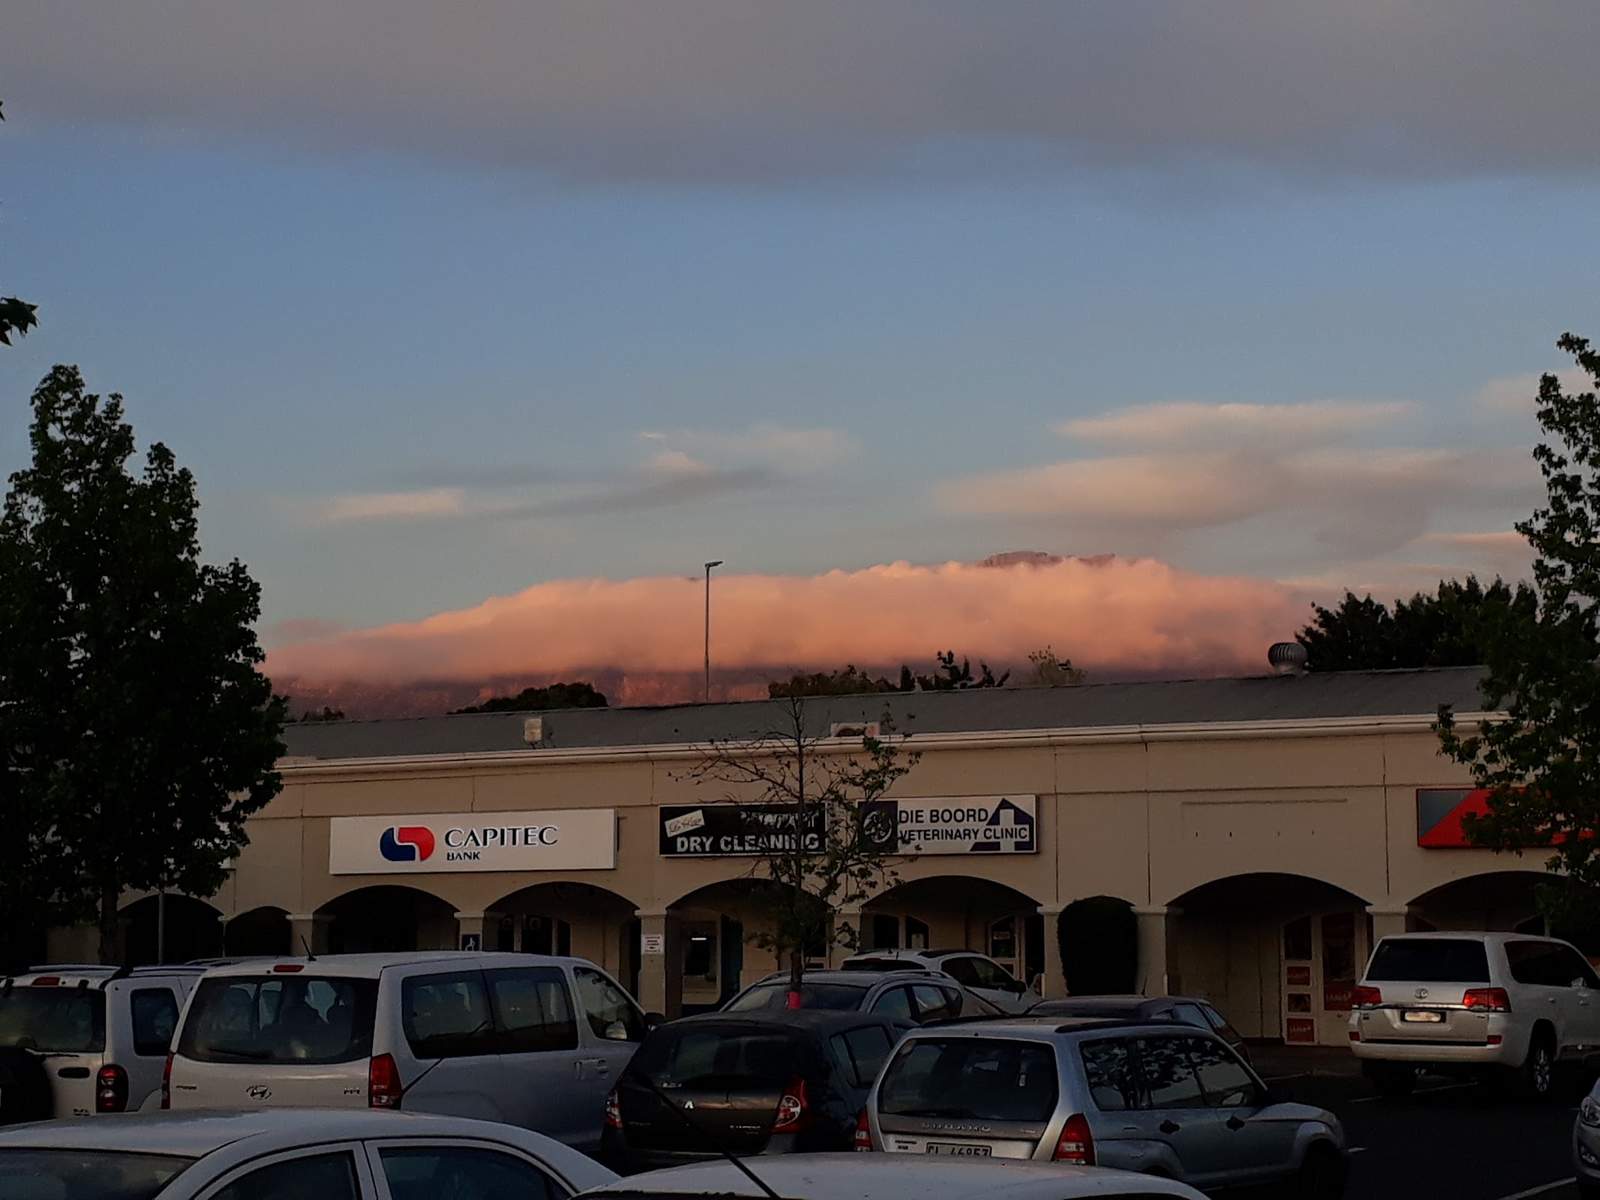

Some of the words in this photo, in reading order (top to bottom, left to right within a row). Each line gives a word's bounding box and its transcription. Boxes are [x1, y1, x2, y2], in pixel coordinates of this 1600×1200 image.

[899, 809, 925, 824] DIE
[929, 808, 989, 824] BOORD
[444, 826, 559, 848] CAPITEC
[899, 828, 980, 841] VETERINARY
[983, 827, 1028, 840] CLINIC
[676, 835, 714, 853] DRY
[719, 833, 819, 852] CLEANING
[446, 851, 481, 861] BANK
